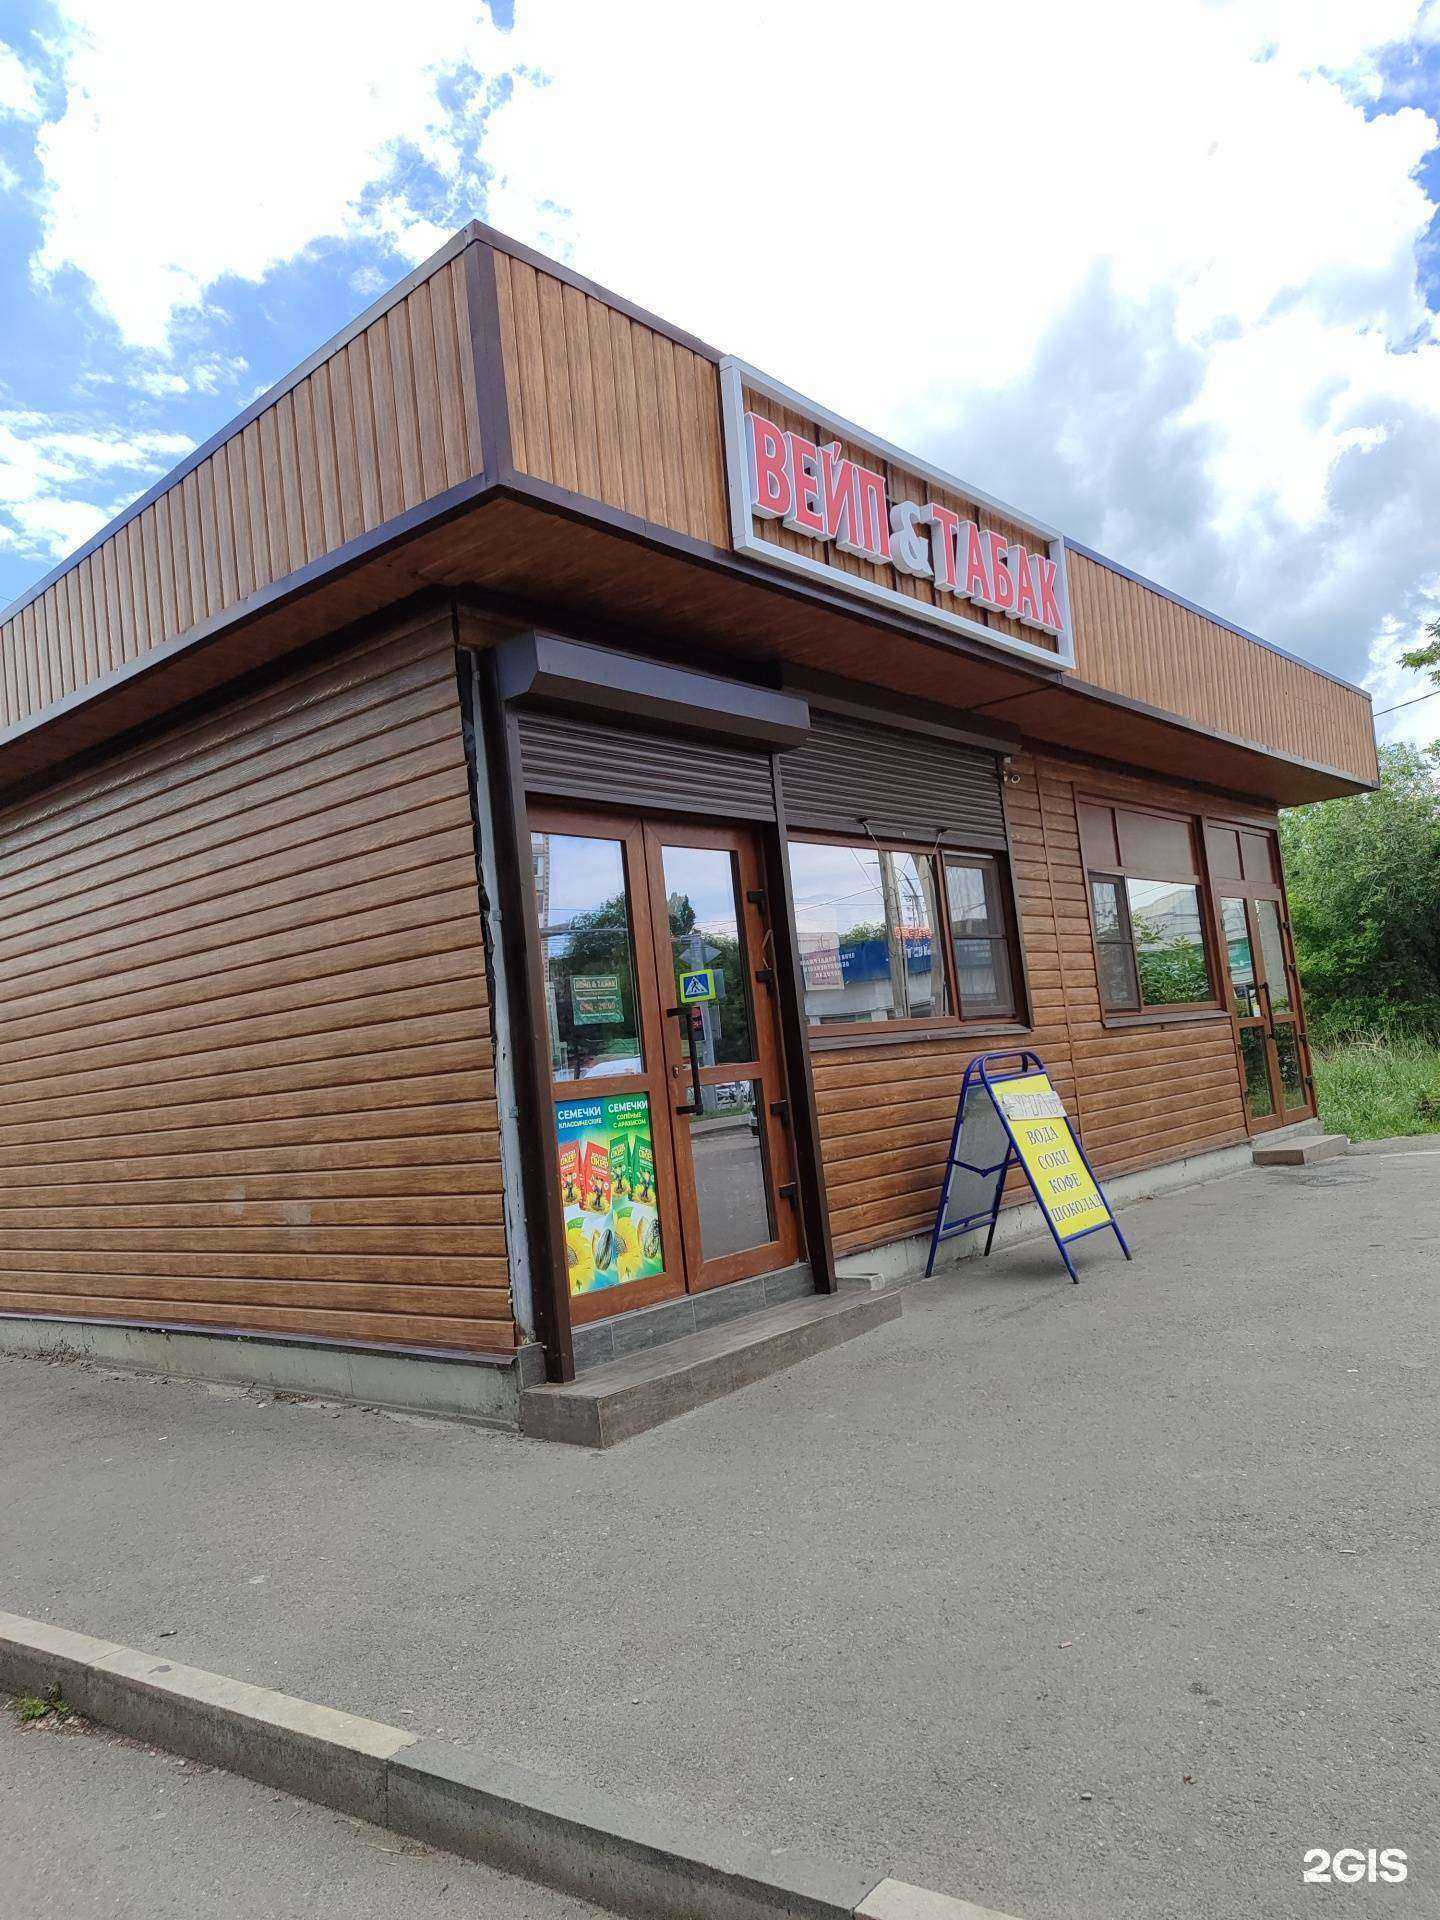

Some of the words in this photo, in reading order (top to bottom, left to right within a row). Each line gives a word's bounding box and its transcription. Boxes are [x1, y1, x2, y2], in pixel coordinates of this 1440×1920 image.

[746, 411, 893, 565] ВЕЙП
[889, 500, 934, 579] &
[919, 502, 1064, 635] ТАБАК
[558, 1106, 602, 1120] СЕМЕЧКИ
[608, 1099, 649, 1113] СЕМЕЧКИ
[559, 1117, 603, 1129] КЛАССИЧЕСКИЕ
[618, 1118, 646, 1128] АРАХИСОМ
[1025, 1124, 1058, 1146] ВОДА
[1037, 1149, 1071, 1170] СОКИ
[1048, 1172, 1082, 1193] КОФЕ
[1050, 1193, 1104, 1223] ШОКОЛАД
